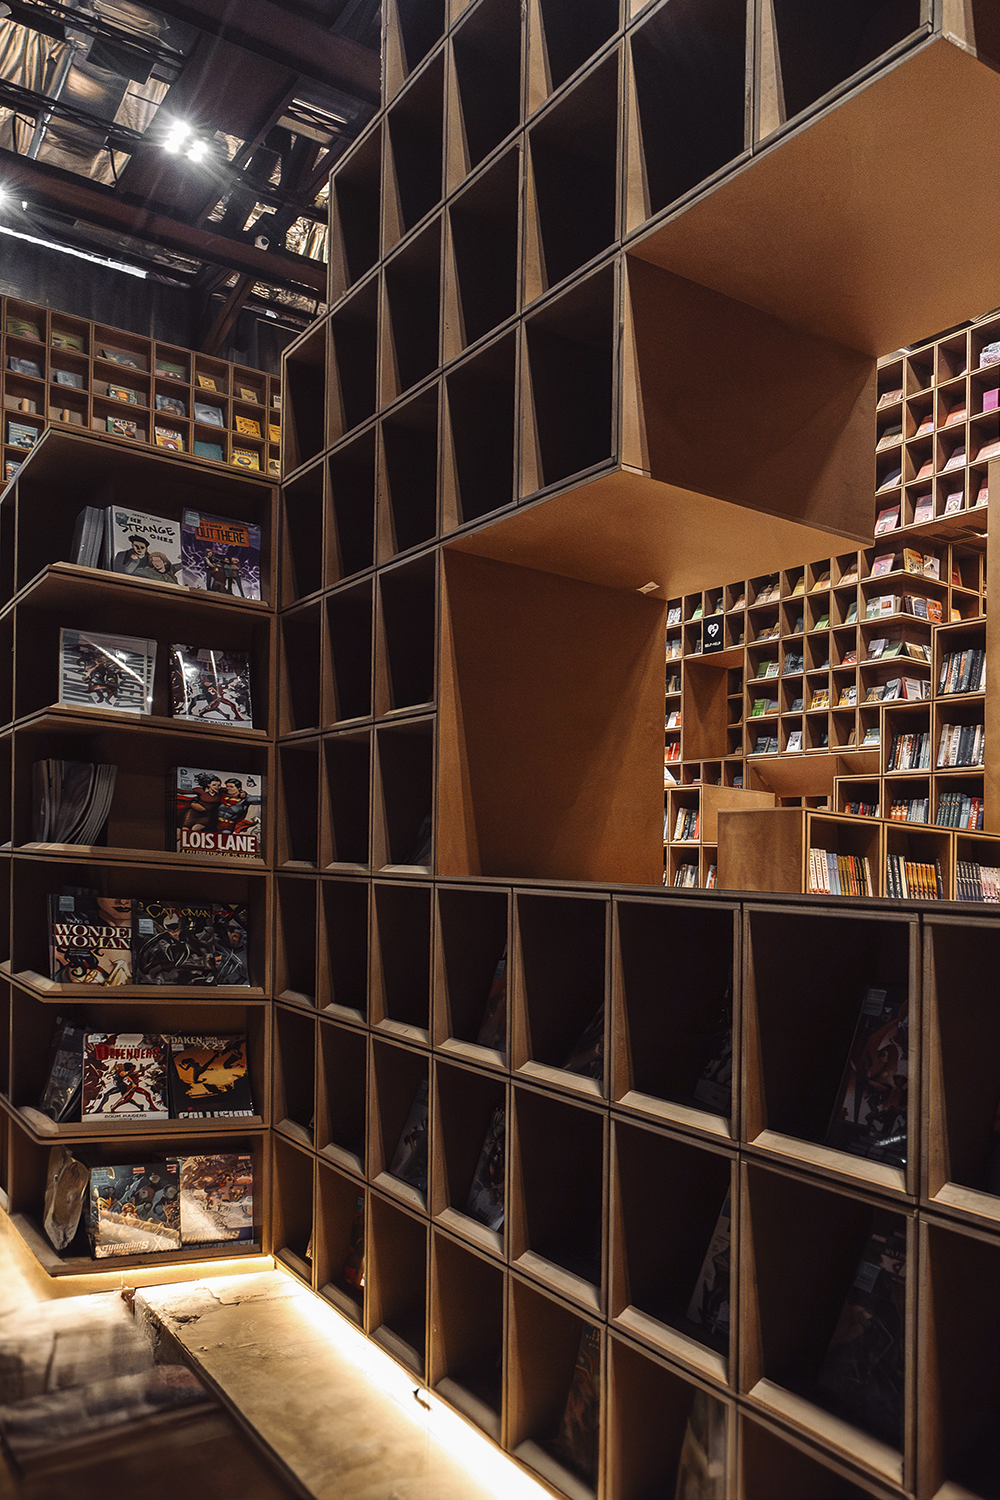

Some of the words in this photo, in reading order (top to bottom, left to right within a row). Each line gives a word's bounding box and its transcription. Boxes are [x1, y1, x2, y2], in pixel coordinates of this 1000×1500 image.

[118, 523, 176, 536] STRANGE
[182, 830, 215, 849] LOIS
[217, 833, 256, 853] LANE
[55, 935, 132, 949] WOMAN
[170, 1036, 203, 1044] DAKEN
